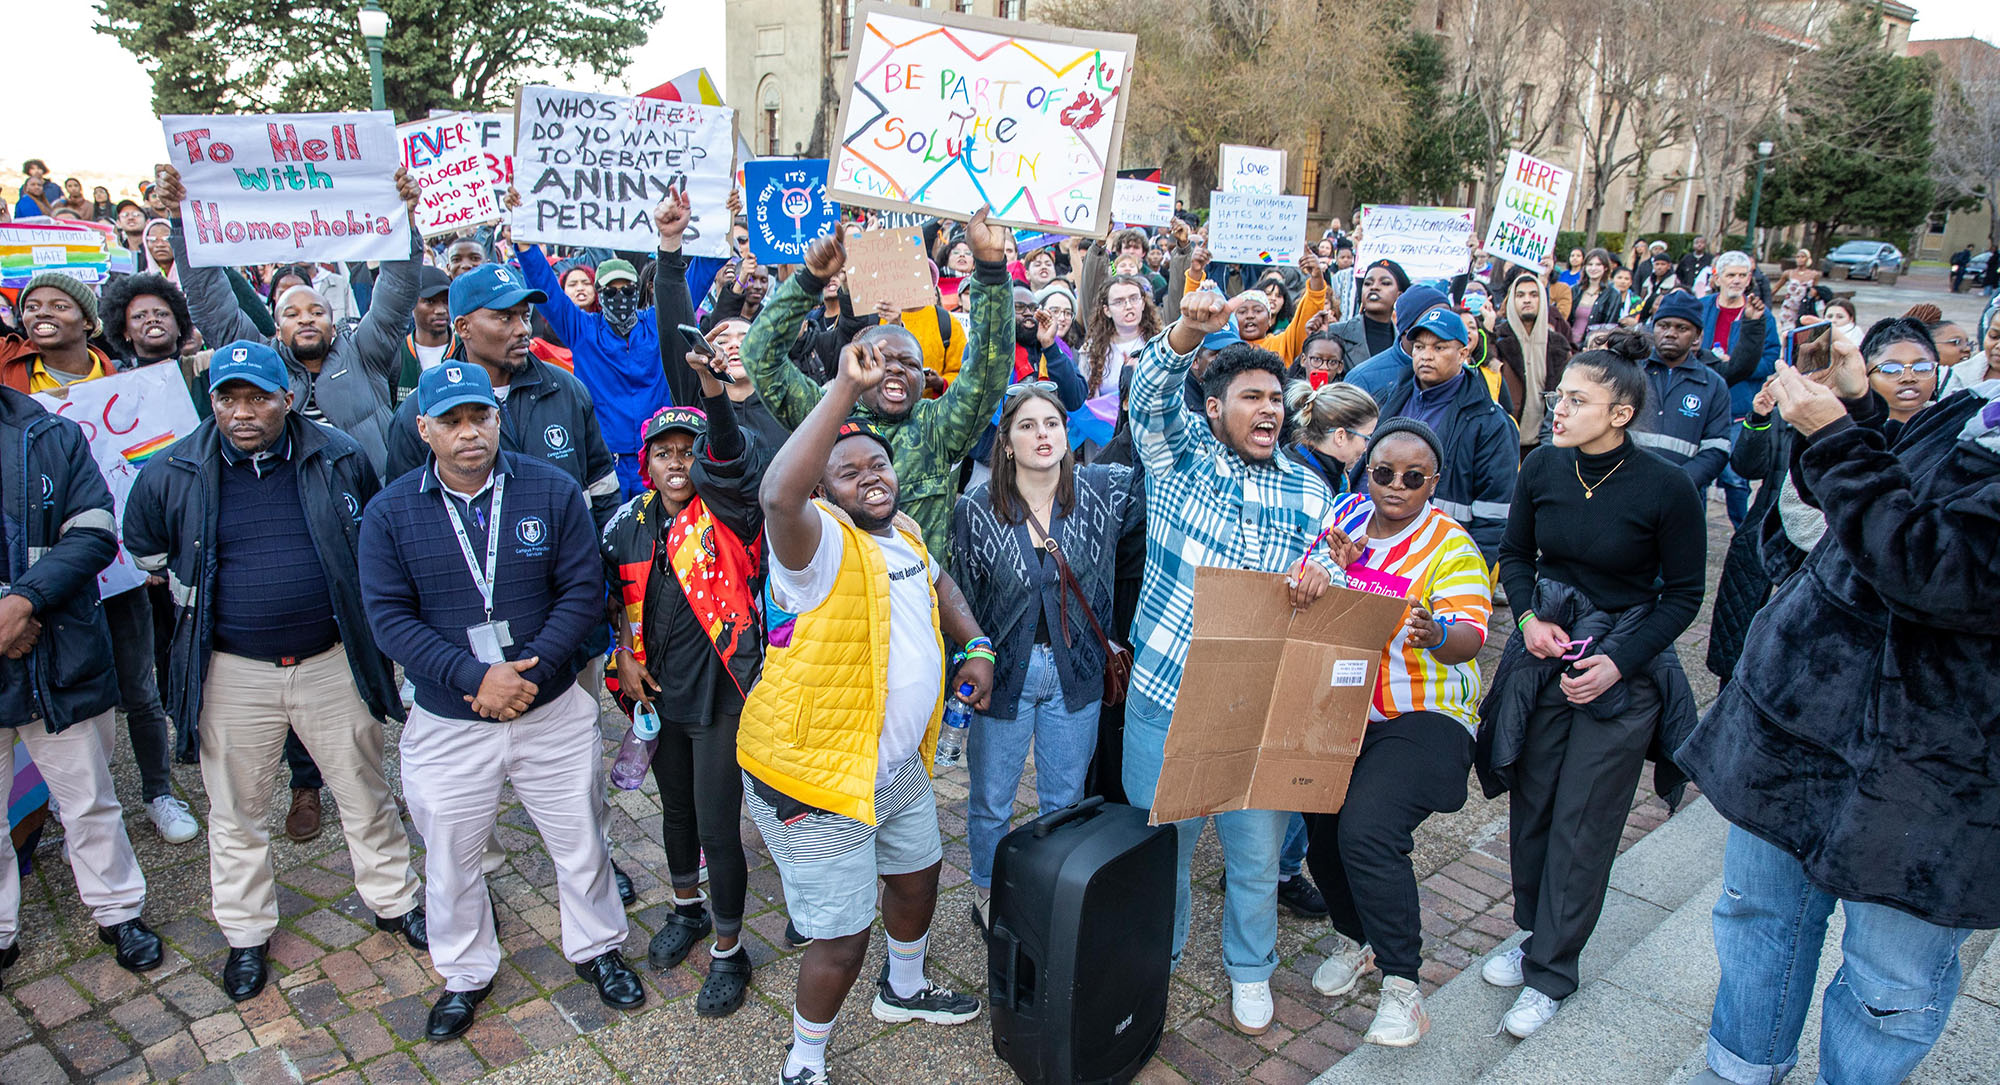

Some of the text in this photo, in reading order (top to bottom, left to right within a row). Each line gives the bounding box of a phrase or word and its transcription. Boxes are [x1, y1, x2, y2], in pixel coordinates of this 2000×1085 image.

[885, 63, 1068, 115] BE PART OF
[536, 97, 683, 123] WHO'S LIFE
[172, 123, 362, 165] To Hell
[531, 122, 697, 149] DO YO WANT
[537, 146, 572, 165] TO
[1236, 156, 1270, 175] Love
[1516, 157, 1564, 196] HERE
[756, 169, 834, 256] IT'S TME TO RASH THE CIS-TEM
[1215, 194, 1241, 206] PROF
[1505, 186, 1558, 225] QUEER
[190, 199, 393, 249] Homophobia
[536, 200, 701, 243] PERHAS
[1218, 209, 1298, 222] HATES US BUT
[1513, 213, 1537, 229] AND
[31, 230, 51, 242] MY
[1490, 220, 1549, 263] AFRICAN
[35, 250, 63, 263] HATE
[658, 412, 699, 427] BRAVE
